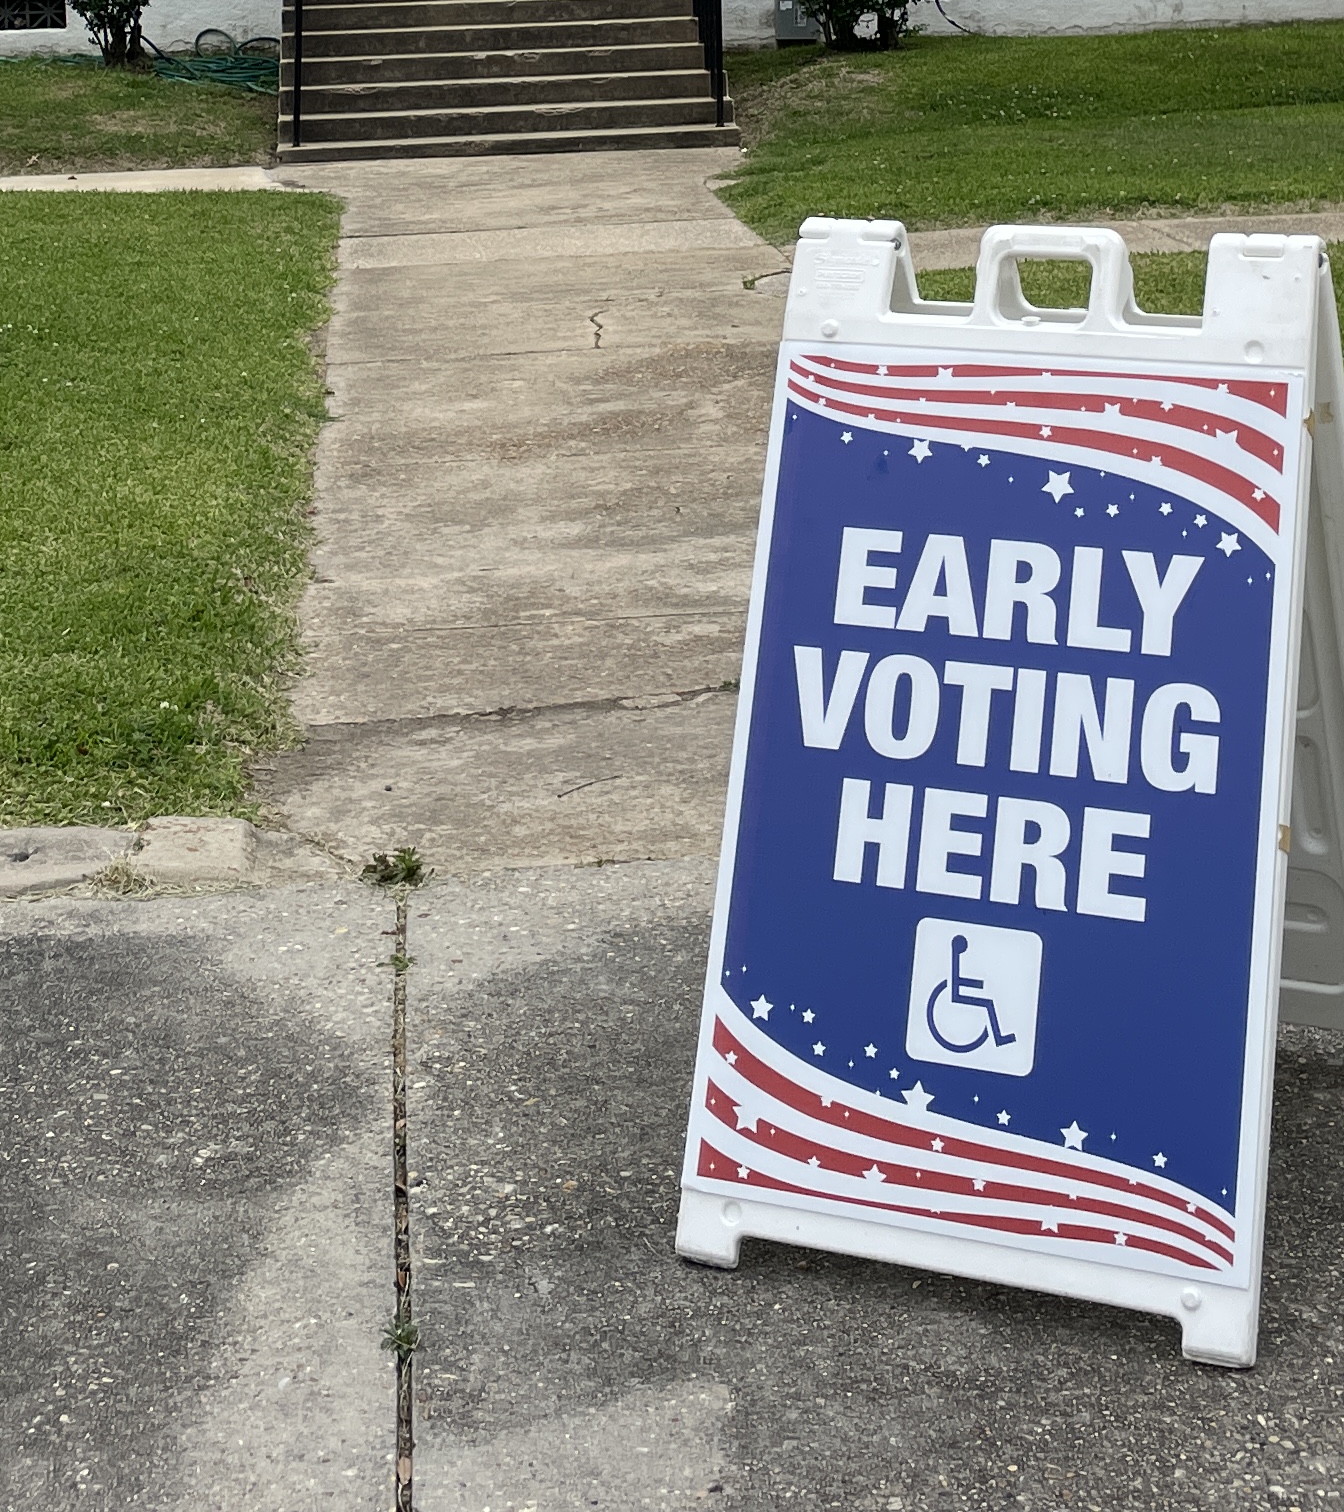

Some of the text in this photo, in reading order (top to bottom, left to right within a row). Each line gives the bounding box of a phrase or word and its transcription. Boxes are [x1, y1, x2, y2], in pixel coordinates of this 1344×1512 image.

[834, 527, 1204, 656] EARLY
[794, 646, 1220, 794] VOTING
[833, 778, 1150, 921] HERE
